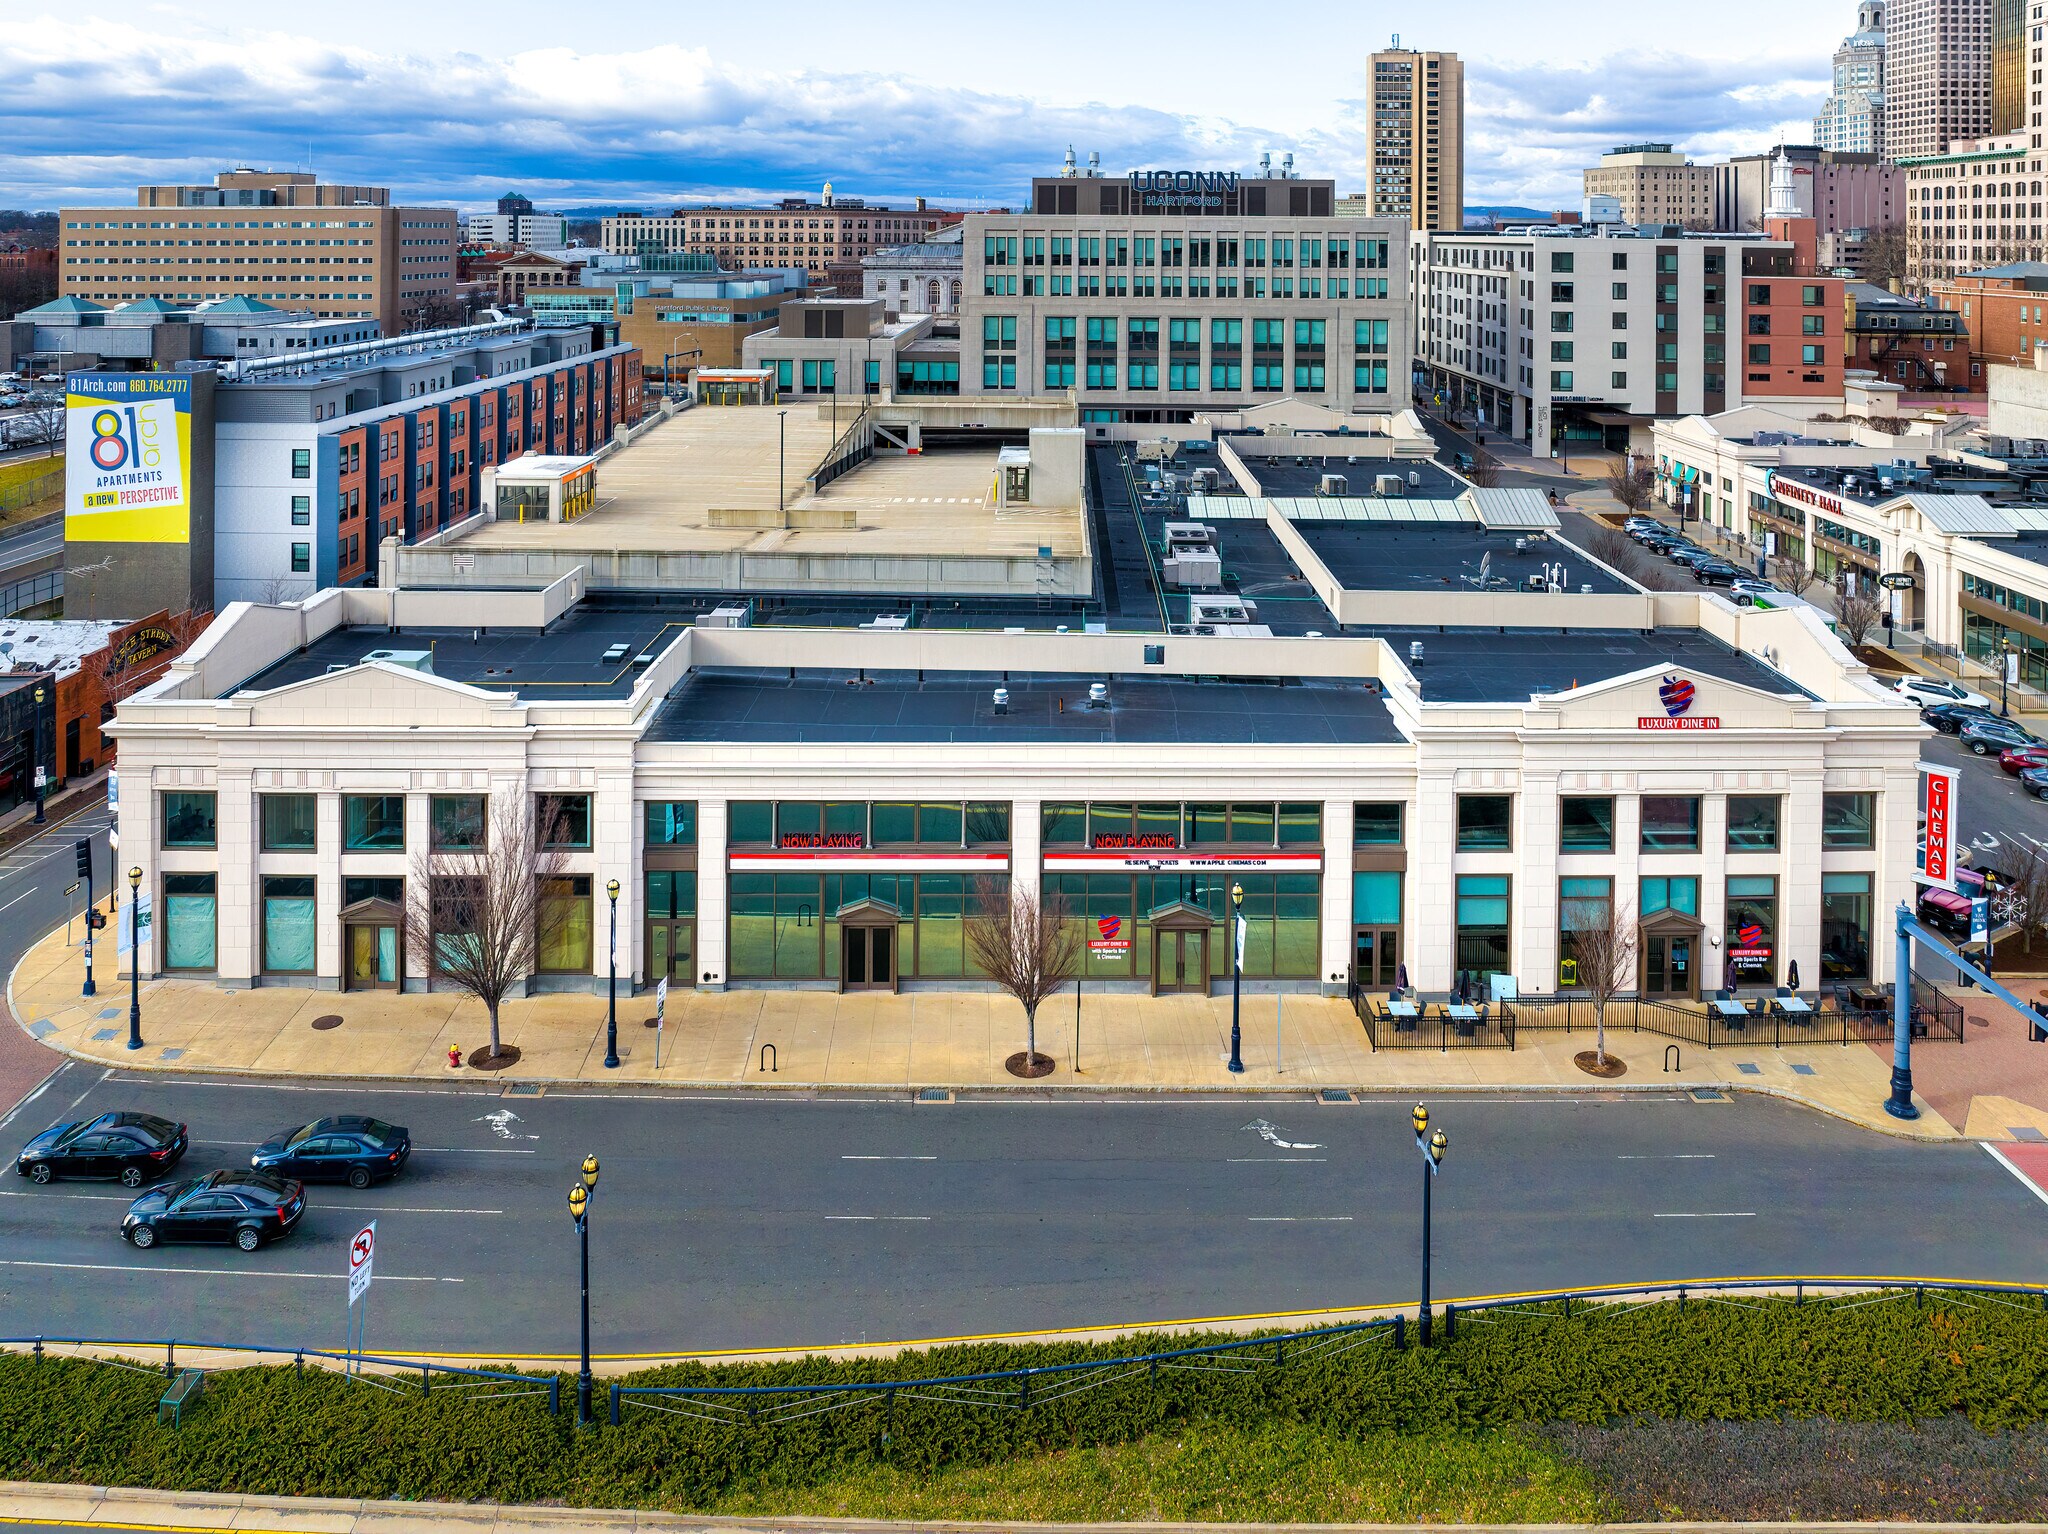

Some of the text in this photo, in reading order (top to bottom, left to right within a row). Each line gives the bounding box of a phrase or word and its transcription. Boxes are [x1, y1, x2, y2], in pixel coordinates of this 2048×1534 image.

[1133, 170, 1236, 192] UCONN
[1146, 195, 1222, 207] HARTFORD
[70, 379, 188, 393] 81Arch.com 860.764.2777
[90, 407, 140, 471] 81
[137, 404, 160, 467] arch
[96, 470, 163, 487] APARTMENTS
[88, 486, 179, 506] a new PERSPECTIVE
[1775, 480, 1844, 516] INFINITY HALL
[140, 628, 171, 642] STREET
[128, 643, 157, 665] TAVERN
[1641, 718, 1717, 729] LUXURY DINE IN
[1930, 780, 1944, 875] CINEMAS
[782, 836, 862, 848] NOW PLAYING
[1096, 837, 1176, 848] NOW PLAYING
[351, 1265, 370, 1289] NO LEFT
[354, 1280, 365, 1295] TURN
